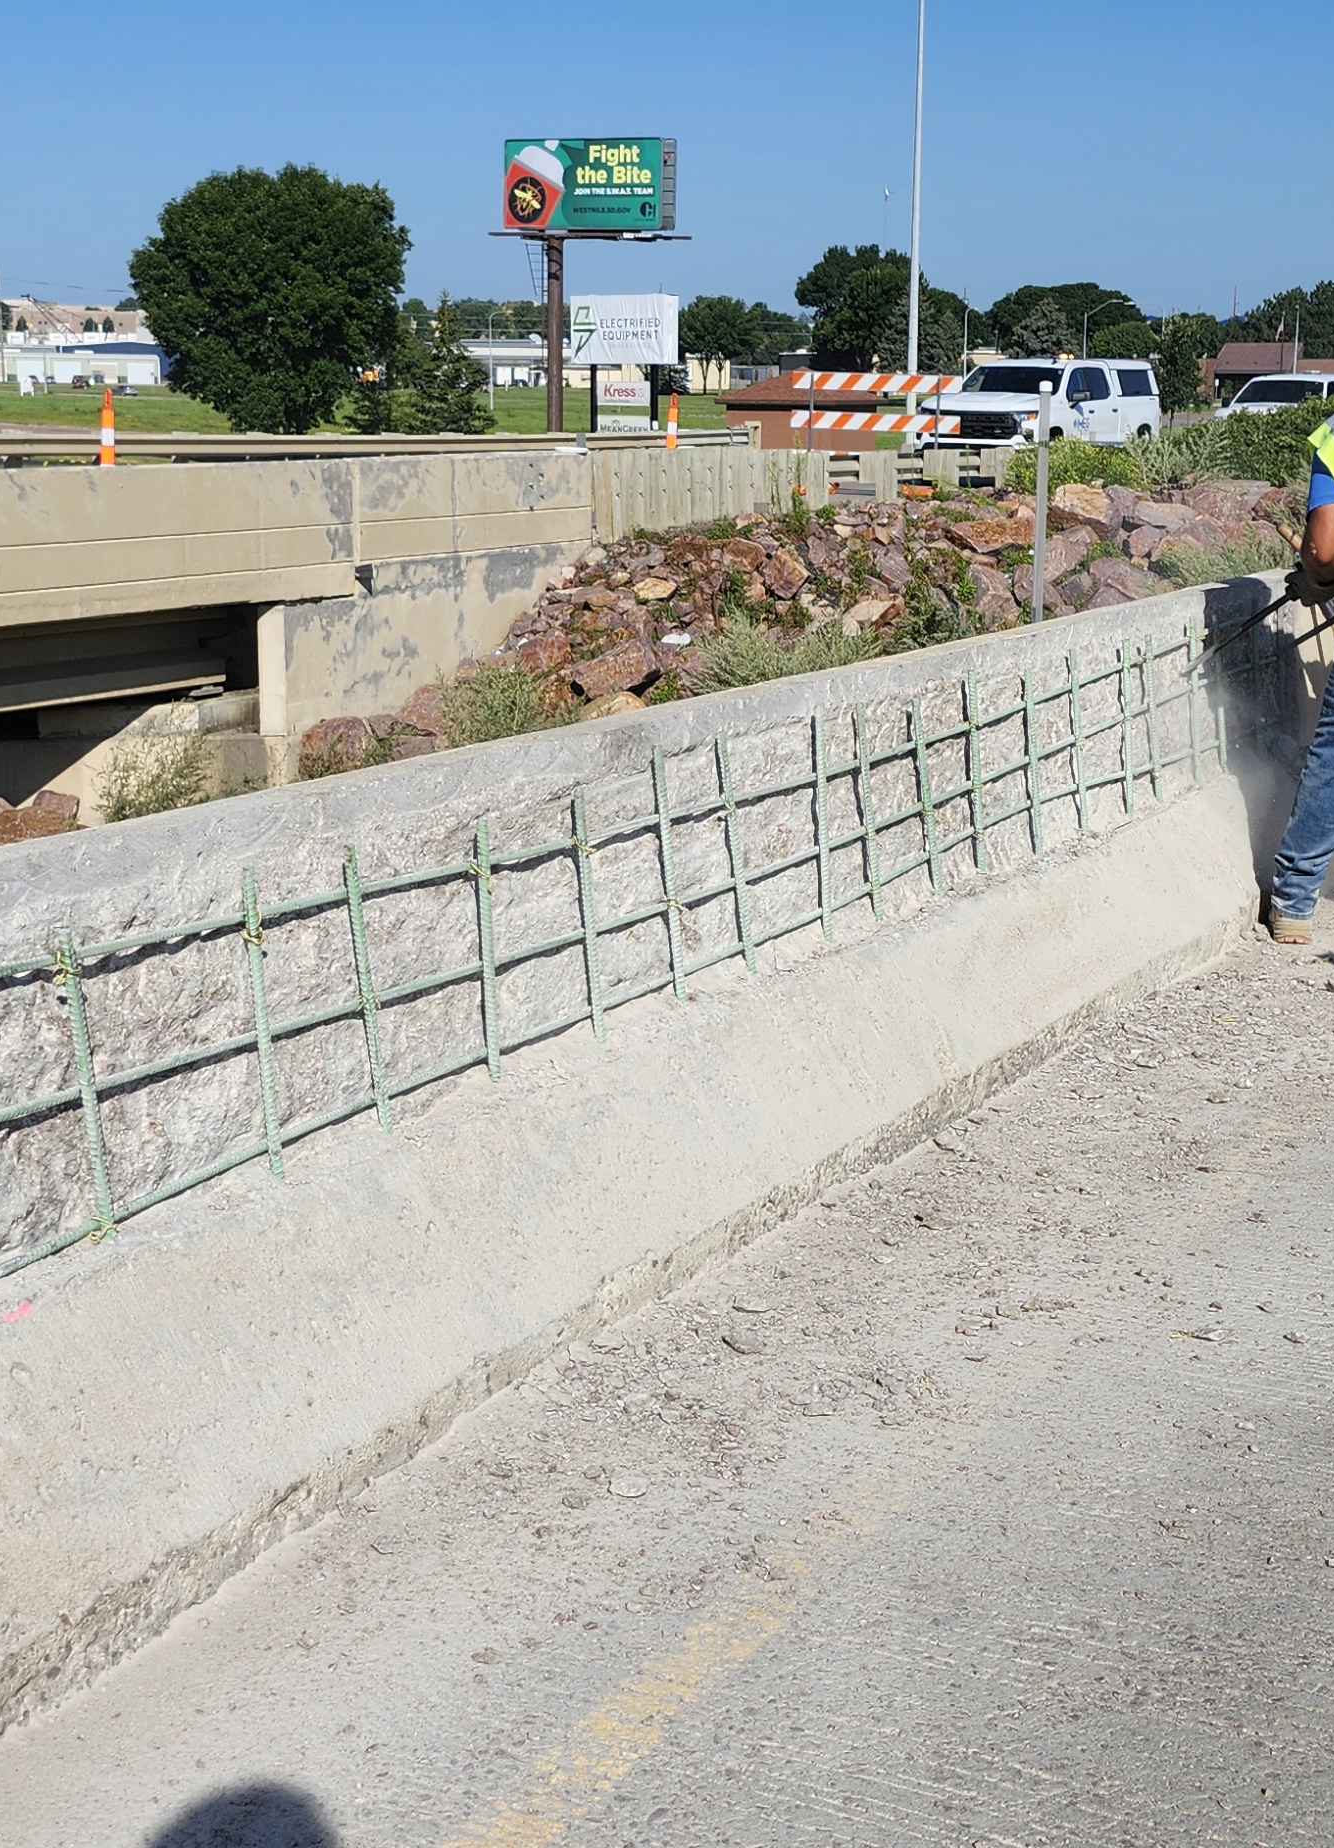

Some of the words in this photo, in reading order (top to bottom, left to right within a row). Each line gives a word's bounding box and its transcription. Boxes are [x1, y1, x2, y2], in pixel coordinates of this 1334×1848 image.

[589, 144, 640, 166] Fight
[576, 165, 608, 184] the
[613, 165, 652, 184] Bite
[574, 187, 591, 195] JOIN
[592, 187, 605, 195] THE
[633, 187, 653, 195] TEAM
[600, 317, 660, 328] ELECTRIFIED
[602, 330, 658, 340] EQUIPMENT
[604, 384, 636, 397] Kress
